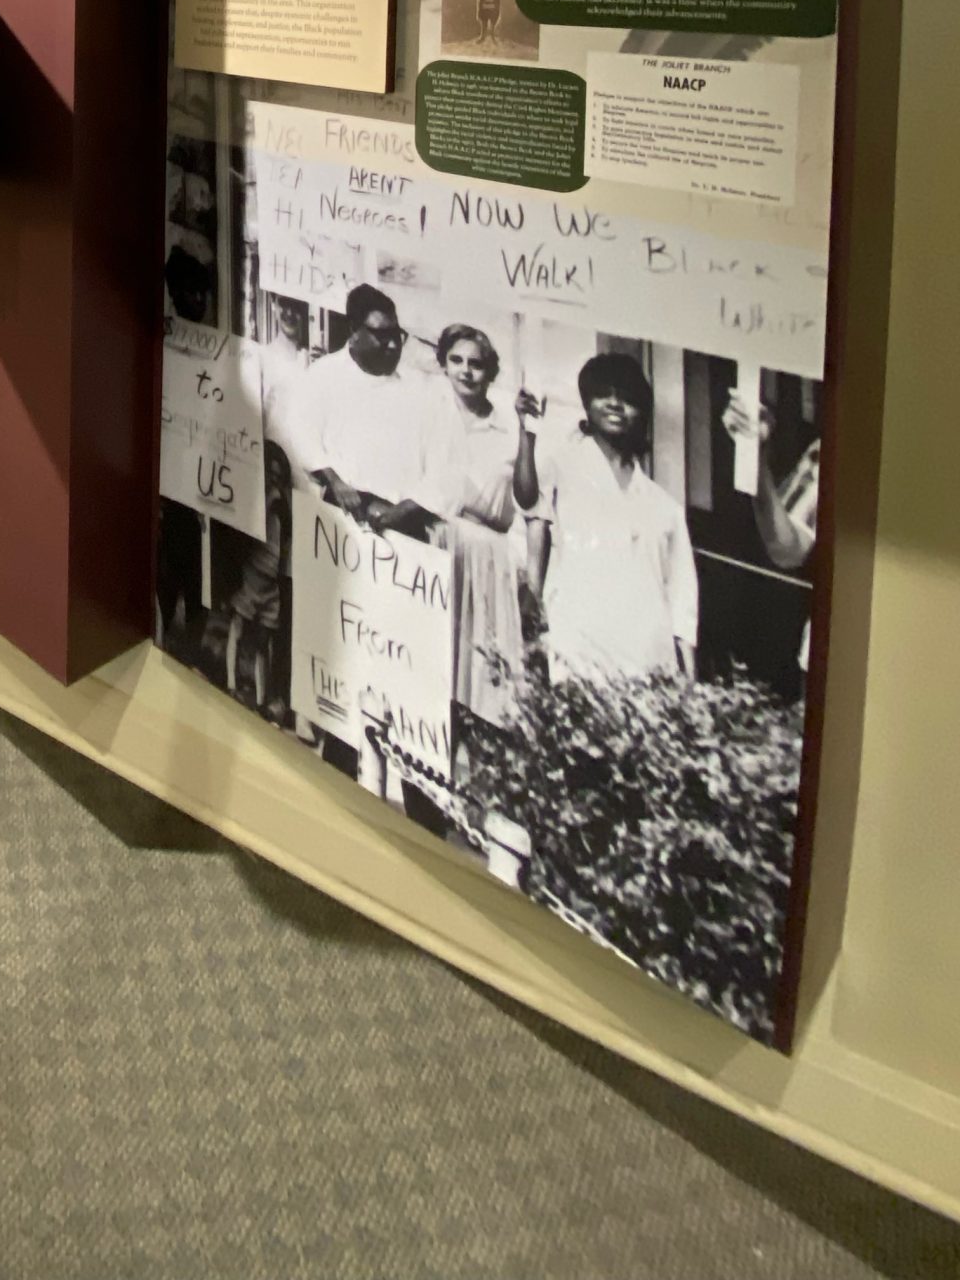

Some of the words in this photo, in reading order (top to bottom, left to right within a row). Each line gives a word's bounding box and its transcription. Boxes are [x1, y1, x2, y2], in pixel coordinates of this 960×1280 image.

[662, 60, 691, 71] JOLIET
[693, 62, 732, 74] BRANCH
[663, 75, 707, 92] NAACP
[450, 189, 524, 230] NOW
[196, 369, 225, 402] to
[197, 454, 234, 503] US
[314, 514, 361, 573] NO
[370, 537, 448, 611] PLAN
